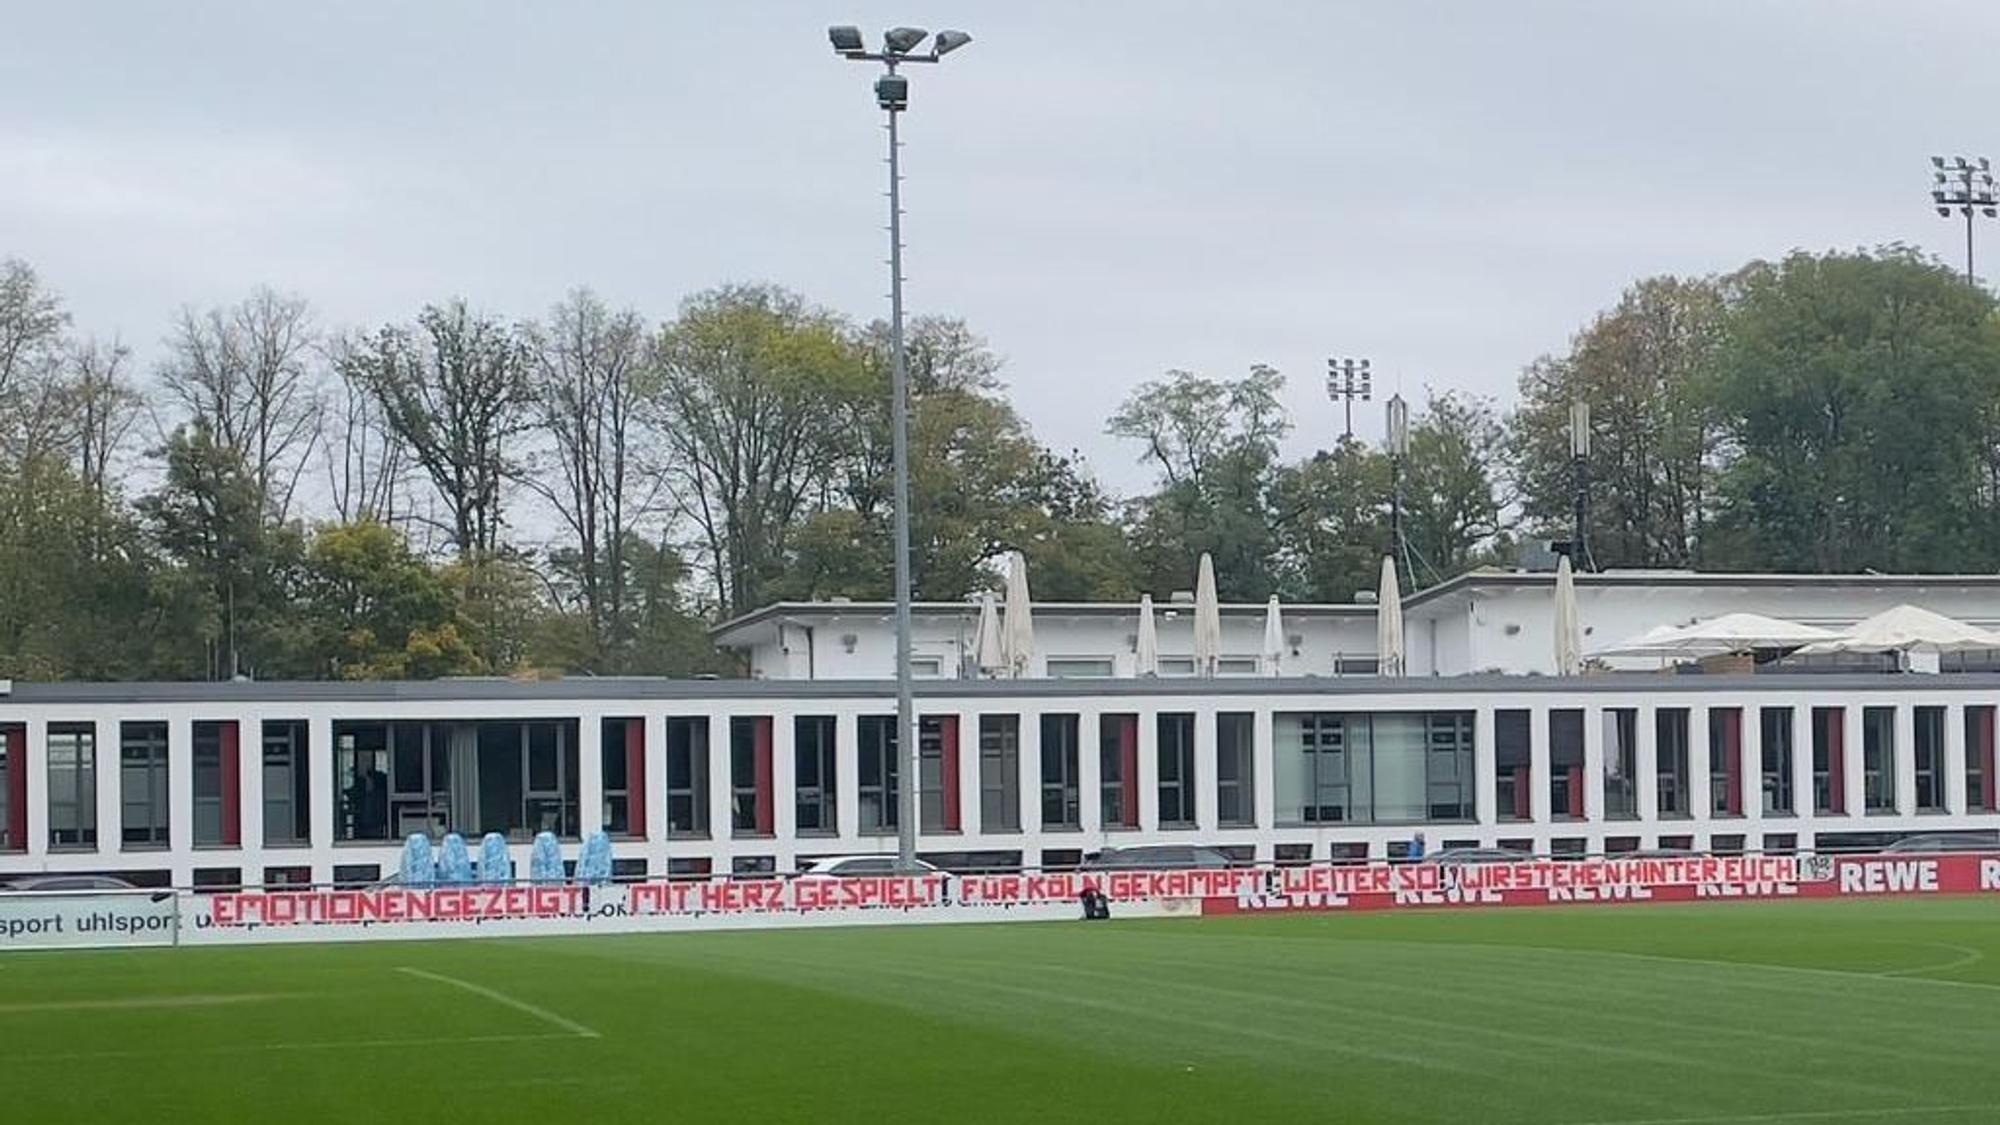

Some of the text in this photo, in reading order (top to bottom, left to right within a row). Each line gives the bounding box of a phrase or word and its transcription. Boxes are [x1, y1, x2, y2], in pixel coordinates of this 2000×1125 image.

[631, 882, 691, 916] MIT
[700, 878, 783, 911] HERZ
[795, 875, 951, 908] GESPIELT!
[962, 876, 1019, 901] FÜR
[1284, 867, 1390, 894] WEITER
[1461, 865, 1511, 890] WIR
[1515, 863, 1620, 887] STEHEN
[1626, 859, 1719, 884] HINTER
[1725, 857, 1800, 881] EUCH!
[1840, 861, 1938, 893] REWE
